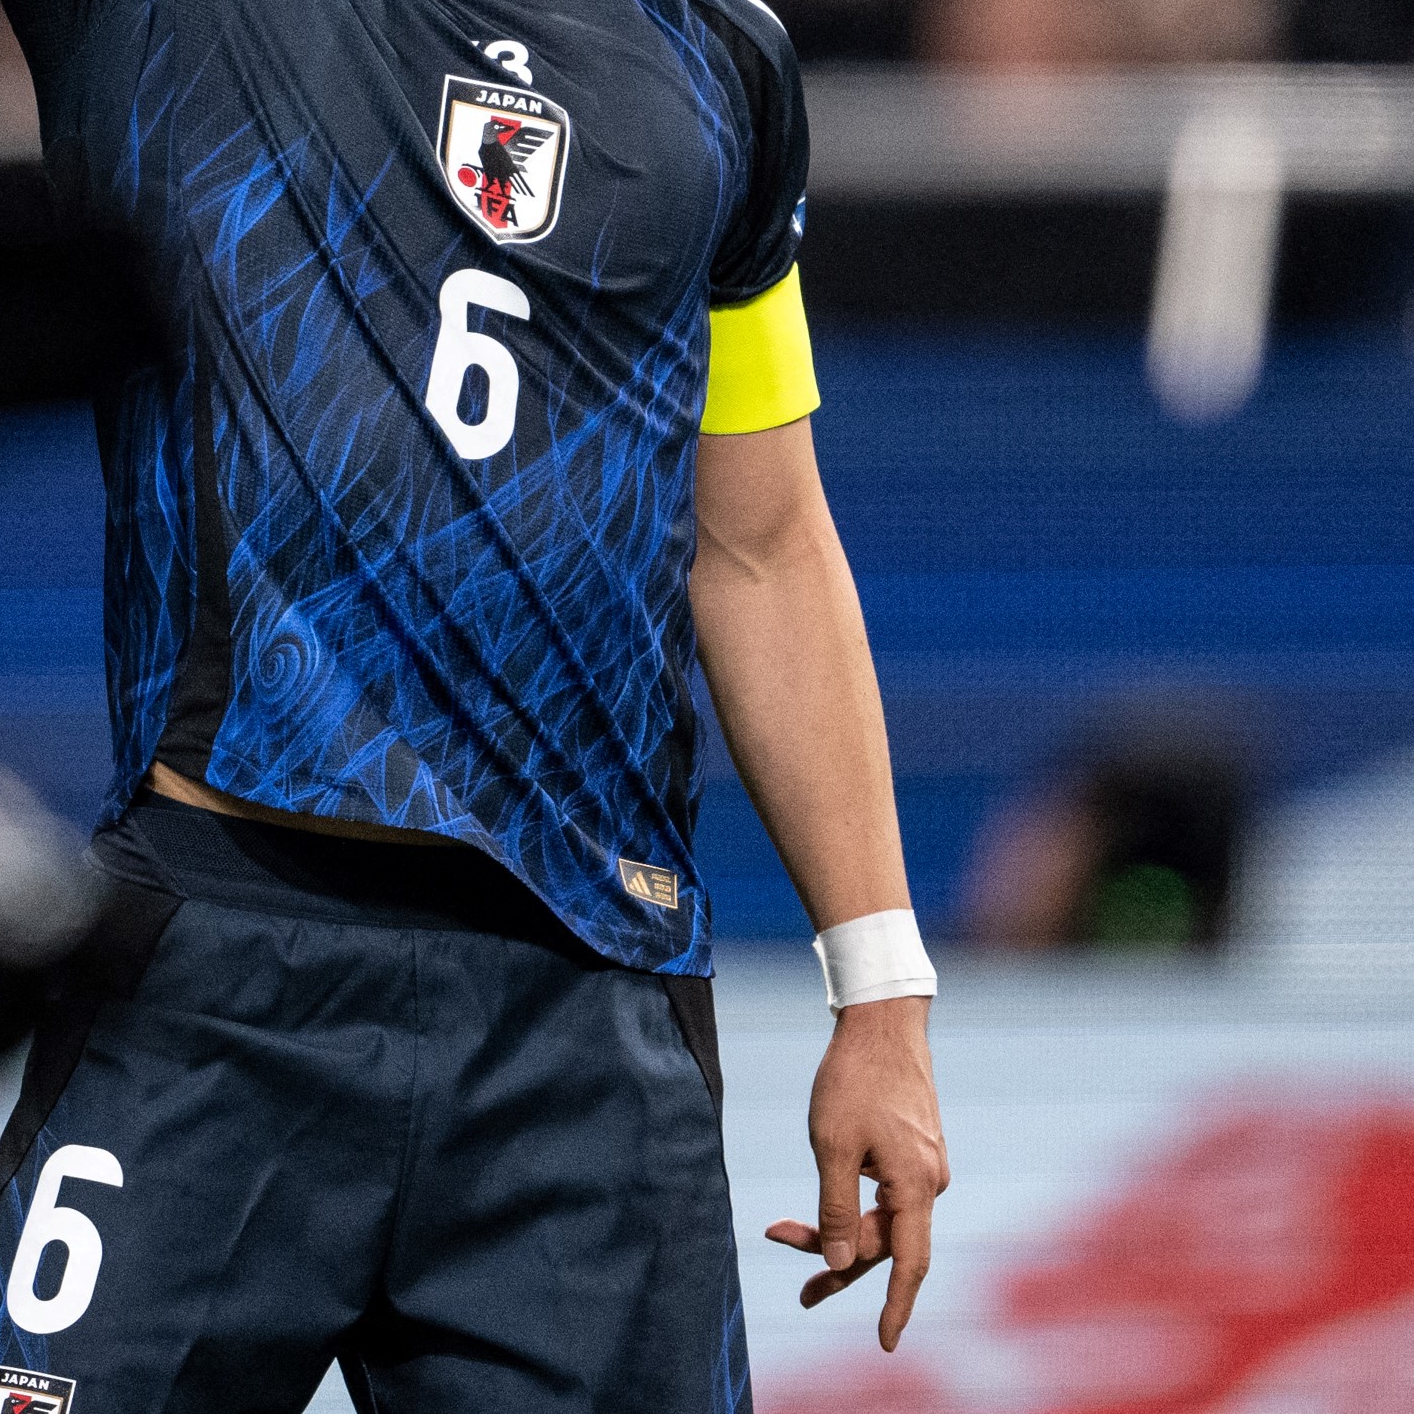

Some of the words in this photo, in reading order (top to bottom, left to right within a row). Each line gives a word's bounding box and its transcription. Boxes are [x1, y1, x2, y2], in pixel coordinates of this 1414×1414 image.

[476, 90, 542, 114] JAPAN
[474, 193, 519, 227] JFA
[425, 269, 530, 459] 6
[7, 1144, 123, 1334] 6
[1, 1373, 49, 1390] JAPAN
